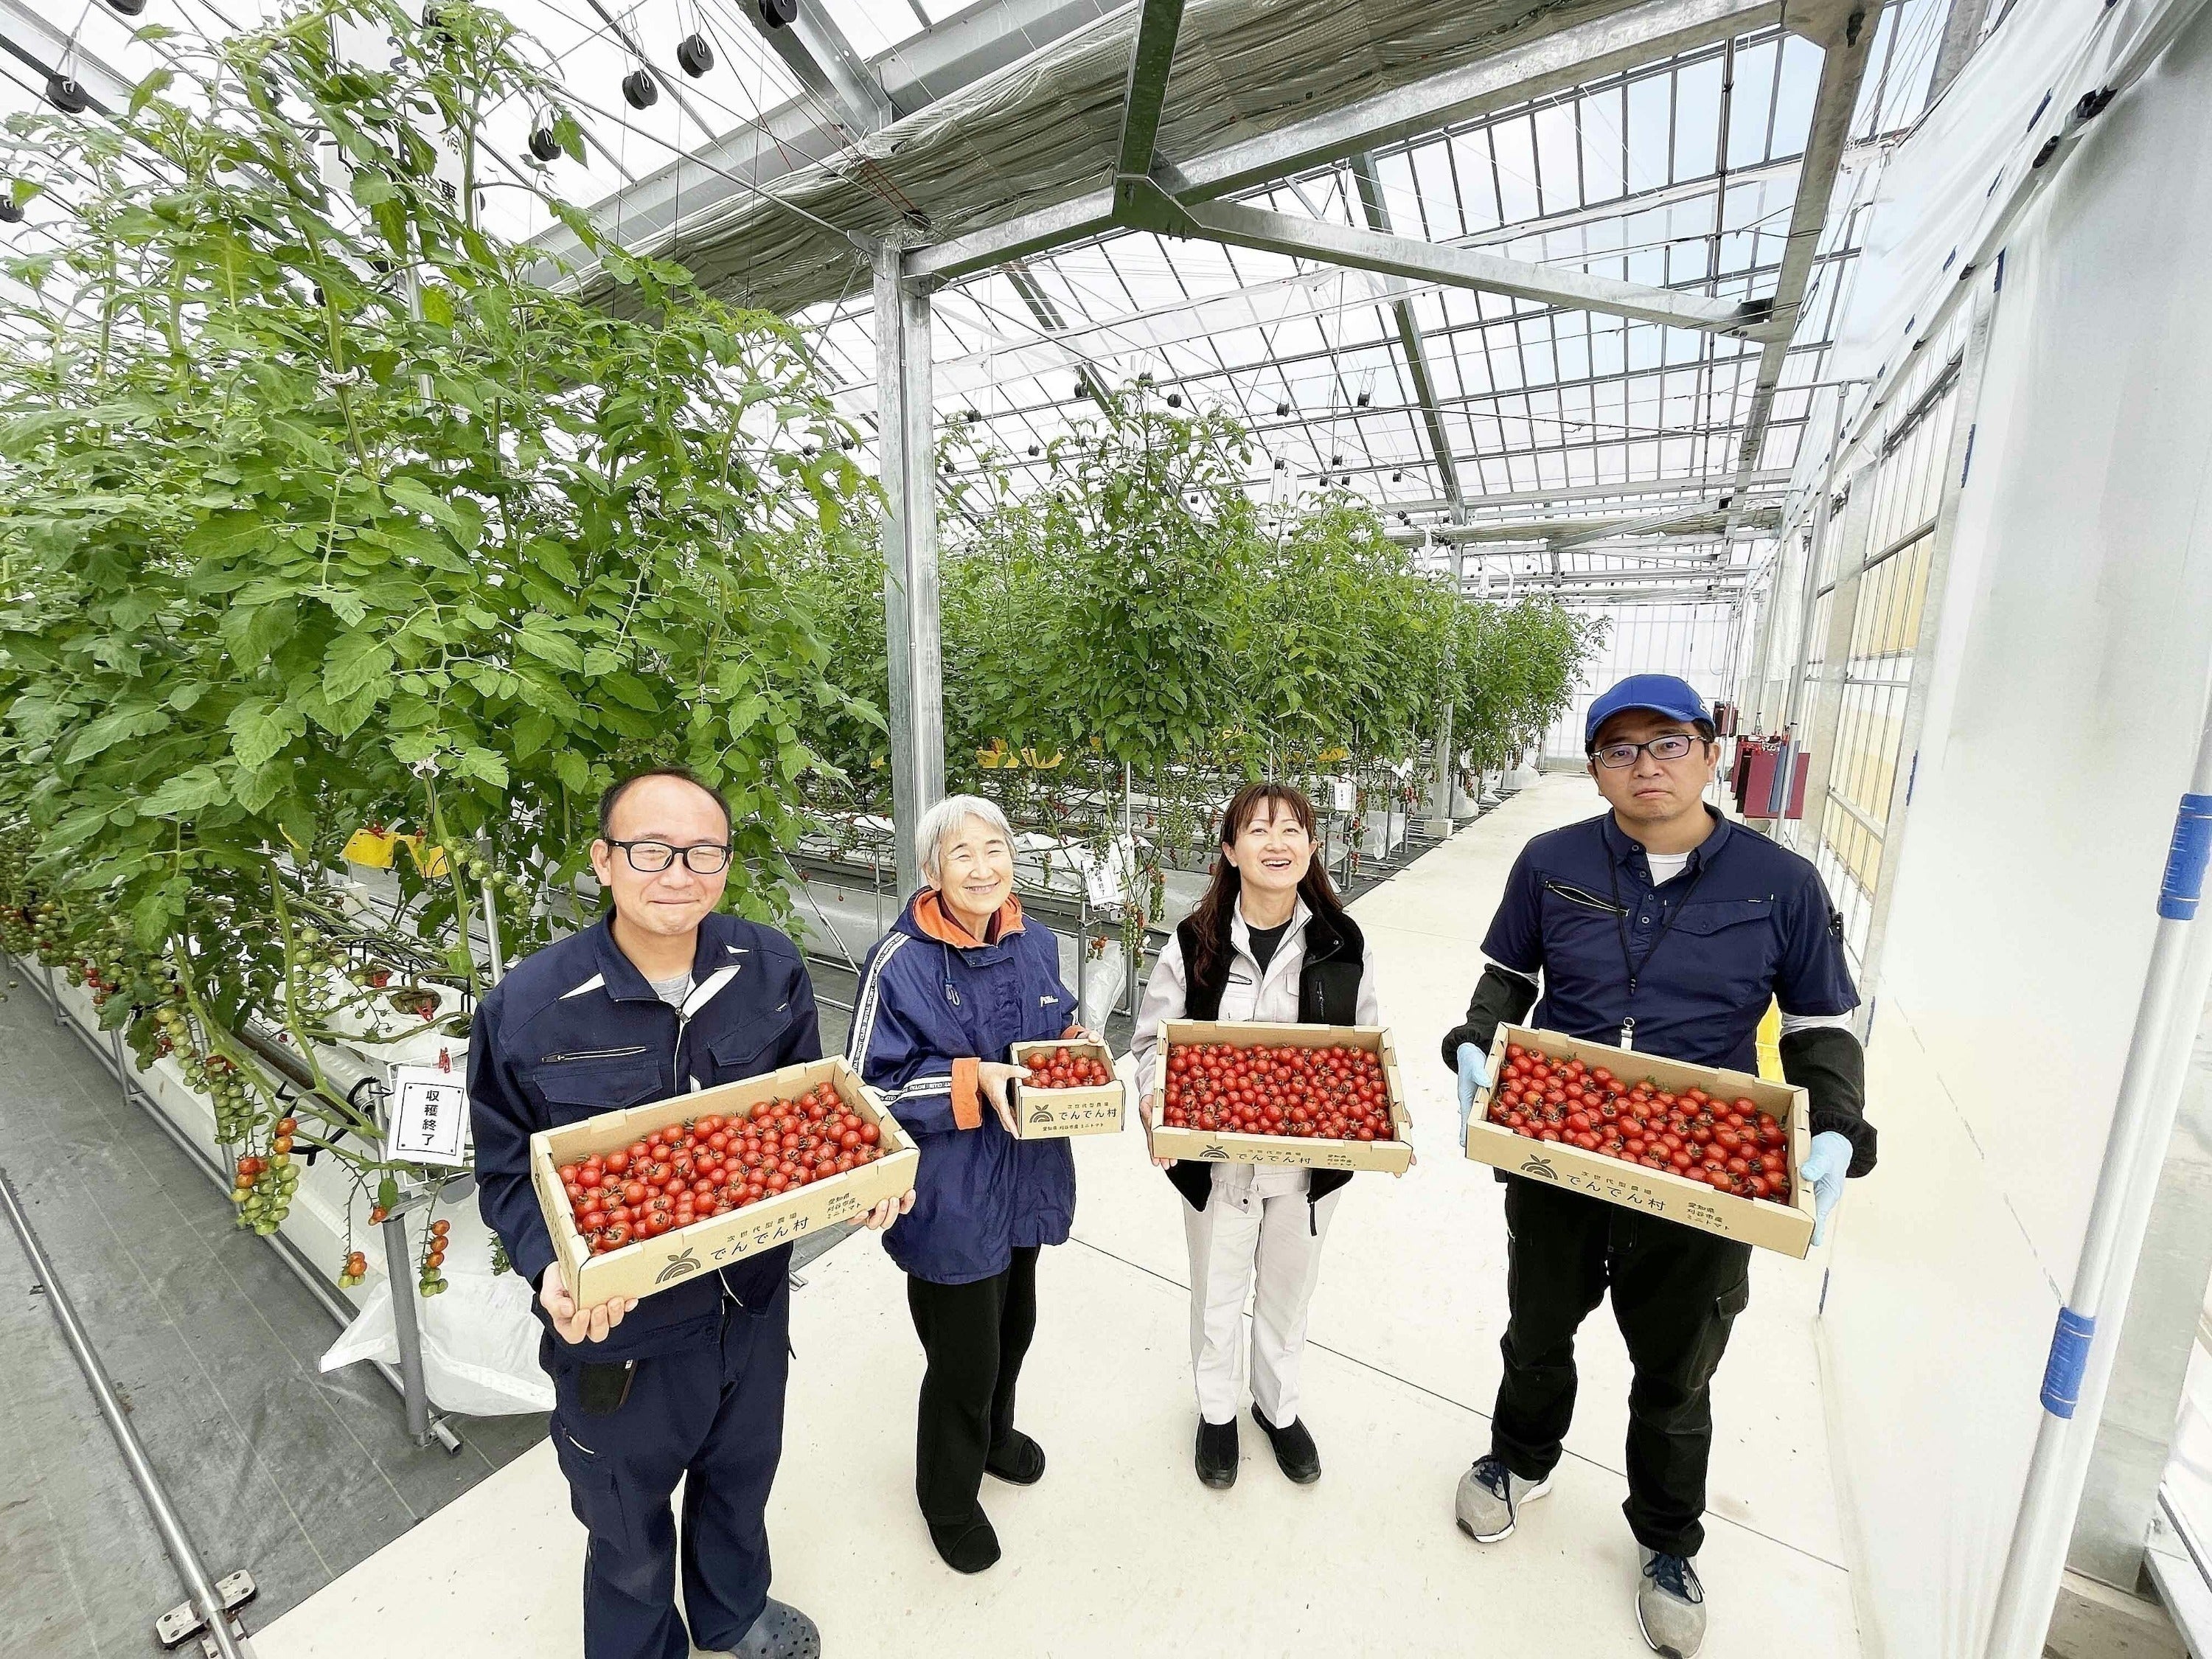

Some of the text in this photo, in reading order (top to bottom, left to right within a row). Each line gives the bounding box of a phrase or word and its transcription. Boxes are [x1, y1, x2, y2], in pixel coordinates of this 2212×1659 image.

[421, 1090, 440, 1146] 収穫終了
[1059, 1108, 1117, 1120] でんでん村
[1237, 1152, 1312, 1164] でんでん村
[1566, 1174, 1666, 1211] でんでん村
[710, 1217, 809, 1261] でんでん村
